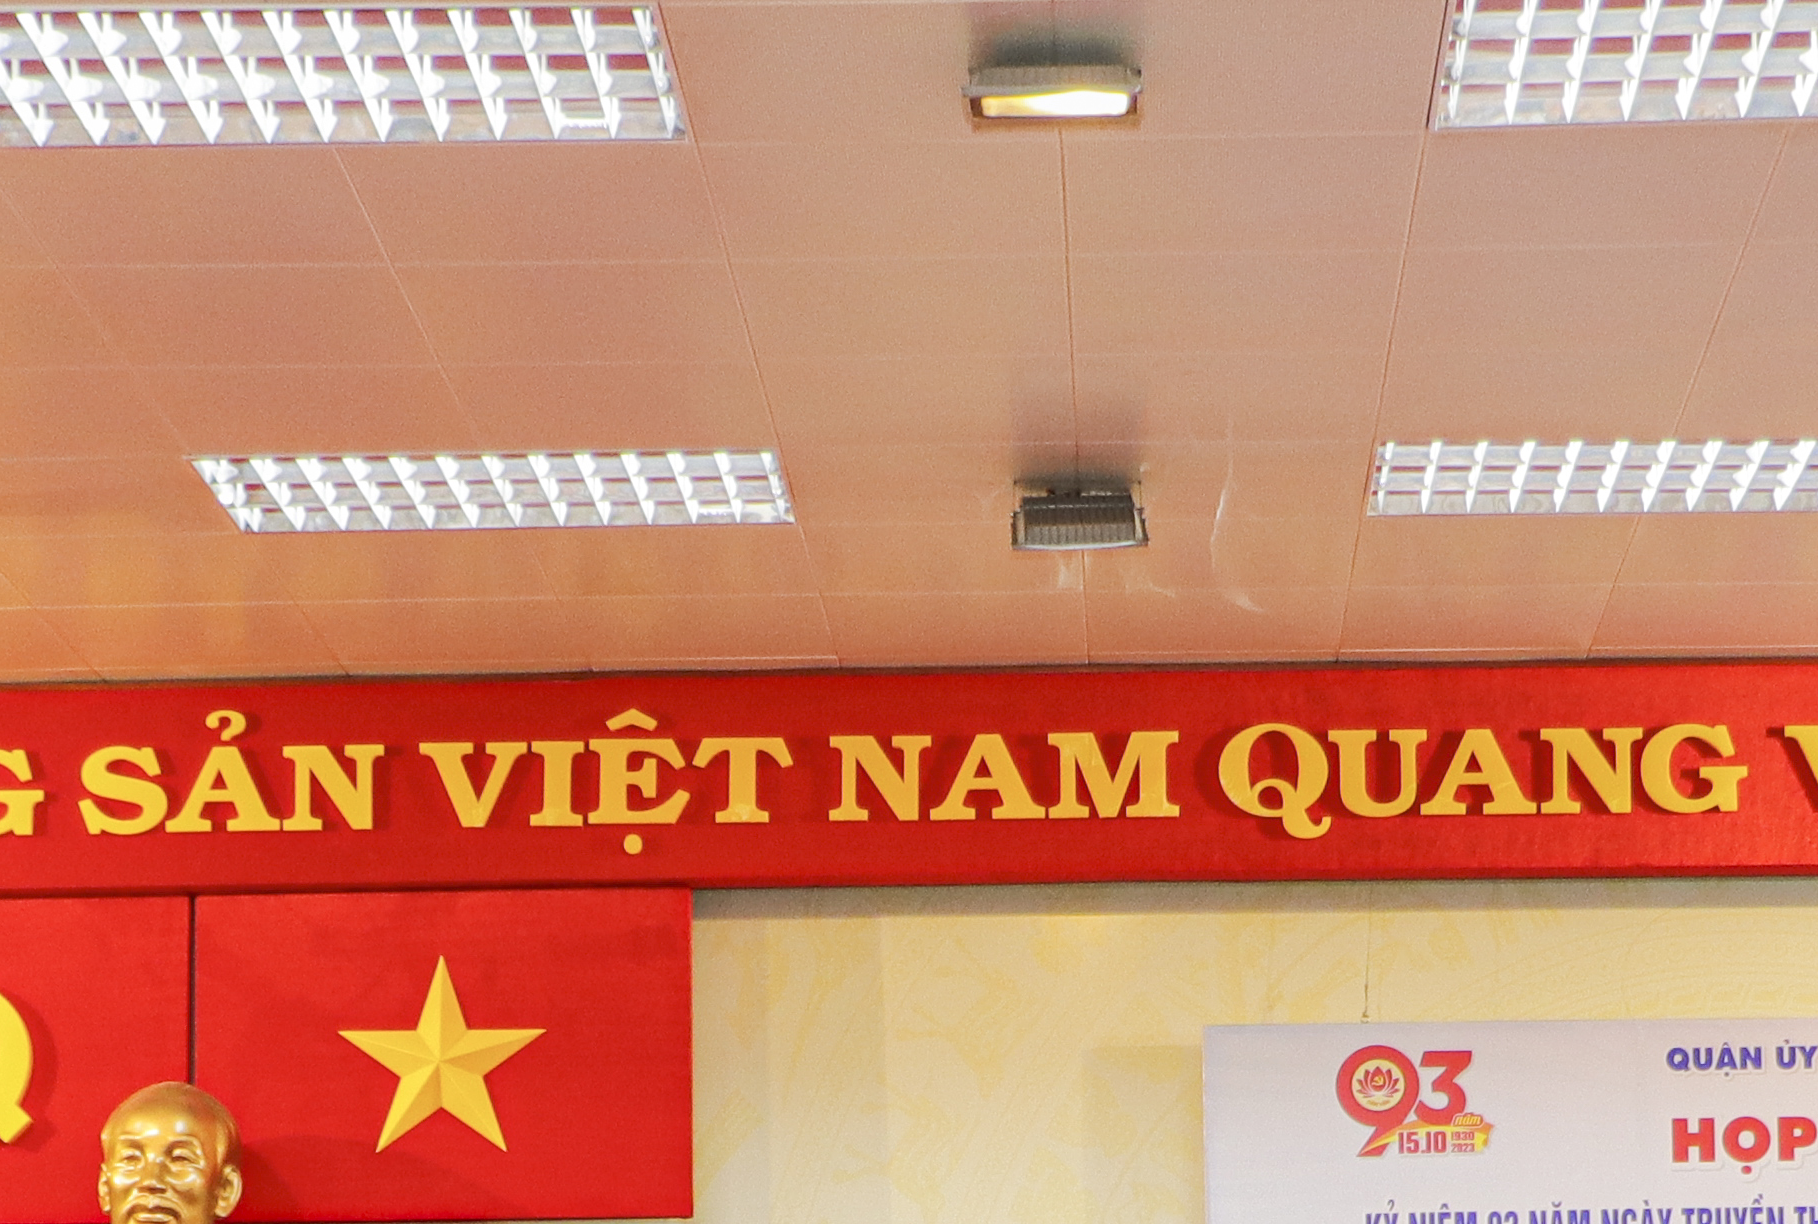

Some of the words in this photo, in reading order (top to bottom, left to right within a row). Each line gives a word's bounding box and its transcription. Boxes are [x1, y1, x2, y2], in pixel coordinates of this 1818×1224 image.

[76, 708, 385, 837] SẢN
[418, 706, 796, 856] VIỆT
[827, 731, 1181, 823] NAM
[1216, 721, 1749, 840] QUANG
[1665, 1042, 1763, 1078] QUẬN
[1775, 1038, 1818, 1070] ỦY
[1397, 1131, 1447, 1155] 15.10
[1671, 1115, 1818, 1176] HỌP
